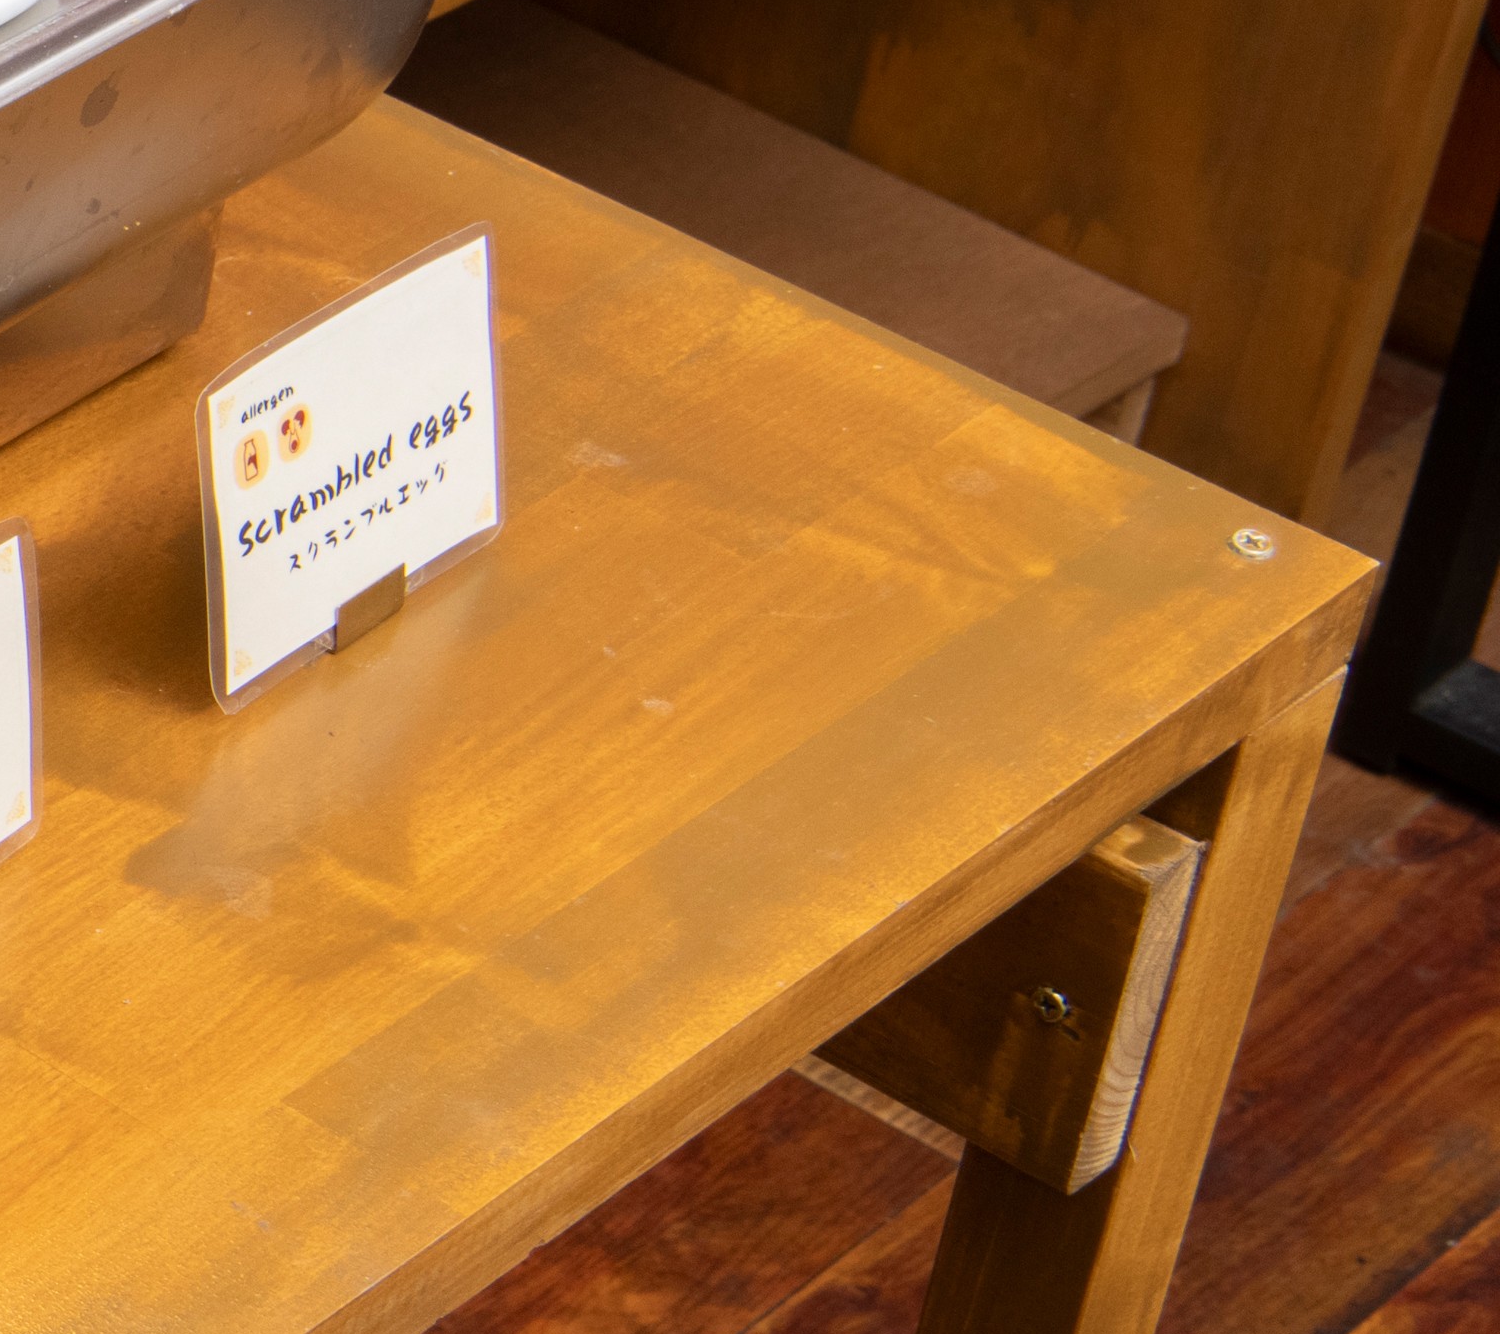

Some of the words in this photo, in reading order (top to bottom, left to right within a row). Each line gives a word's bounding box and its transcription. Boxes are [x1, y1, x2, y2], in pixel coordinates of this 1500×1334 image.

[240, 384, 294, 424] allergen
[408, 390, 473, 450] eggs
[288, 459, 449, 573] スクランブルエッグ
